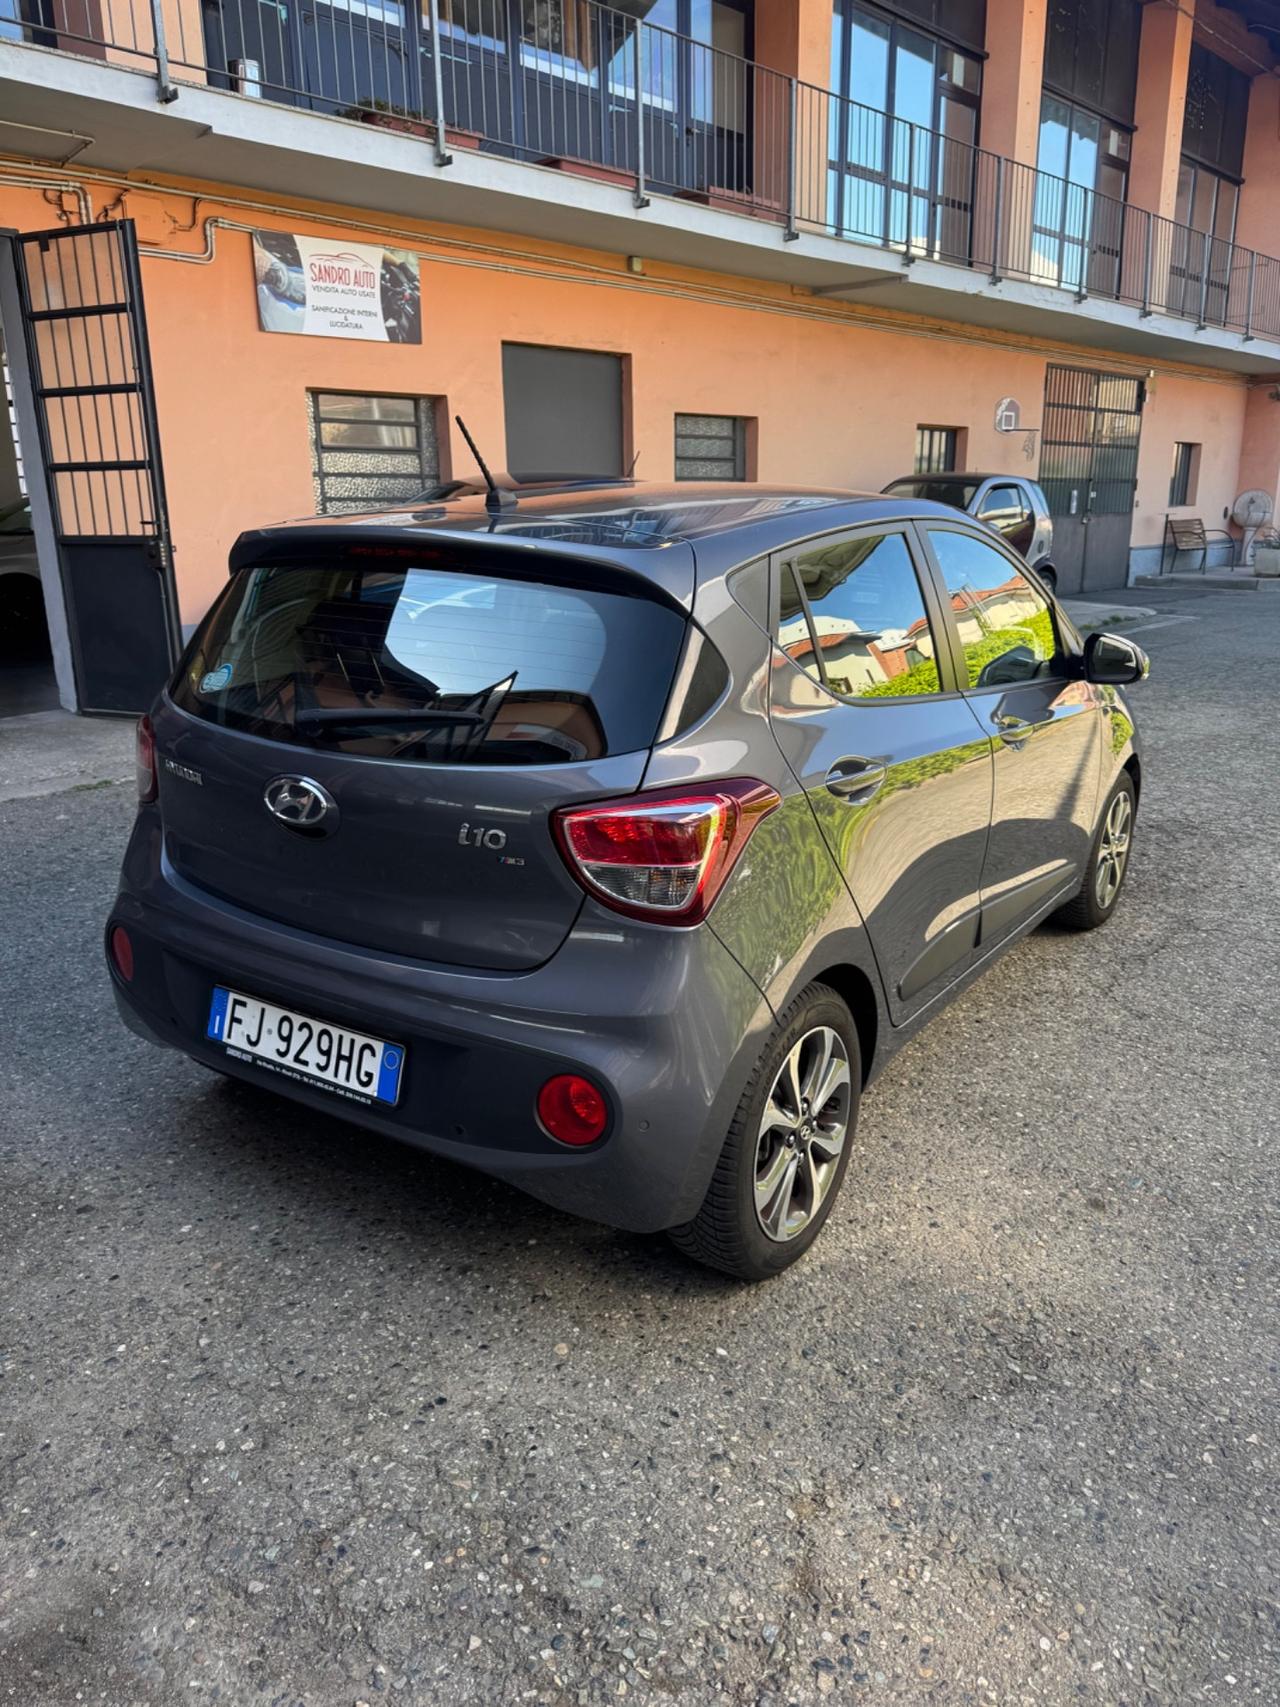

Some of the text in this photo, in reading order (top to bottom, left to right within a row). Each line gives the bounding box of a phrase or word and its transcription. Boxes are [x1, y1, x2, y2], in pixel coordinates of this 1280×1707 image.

[309, 262, 376, 289] SANDRO AUTO
[311, 285, 376, 298] VENDITA AUTO USATE
[311, 304, 378, 318] SANIFICAZIONE INTERNI
[329, 320, 363, 329] LUCIDATURA
[458, 823, 507, 850] i10
